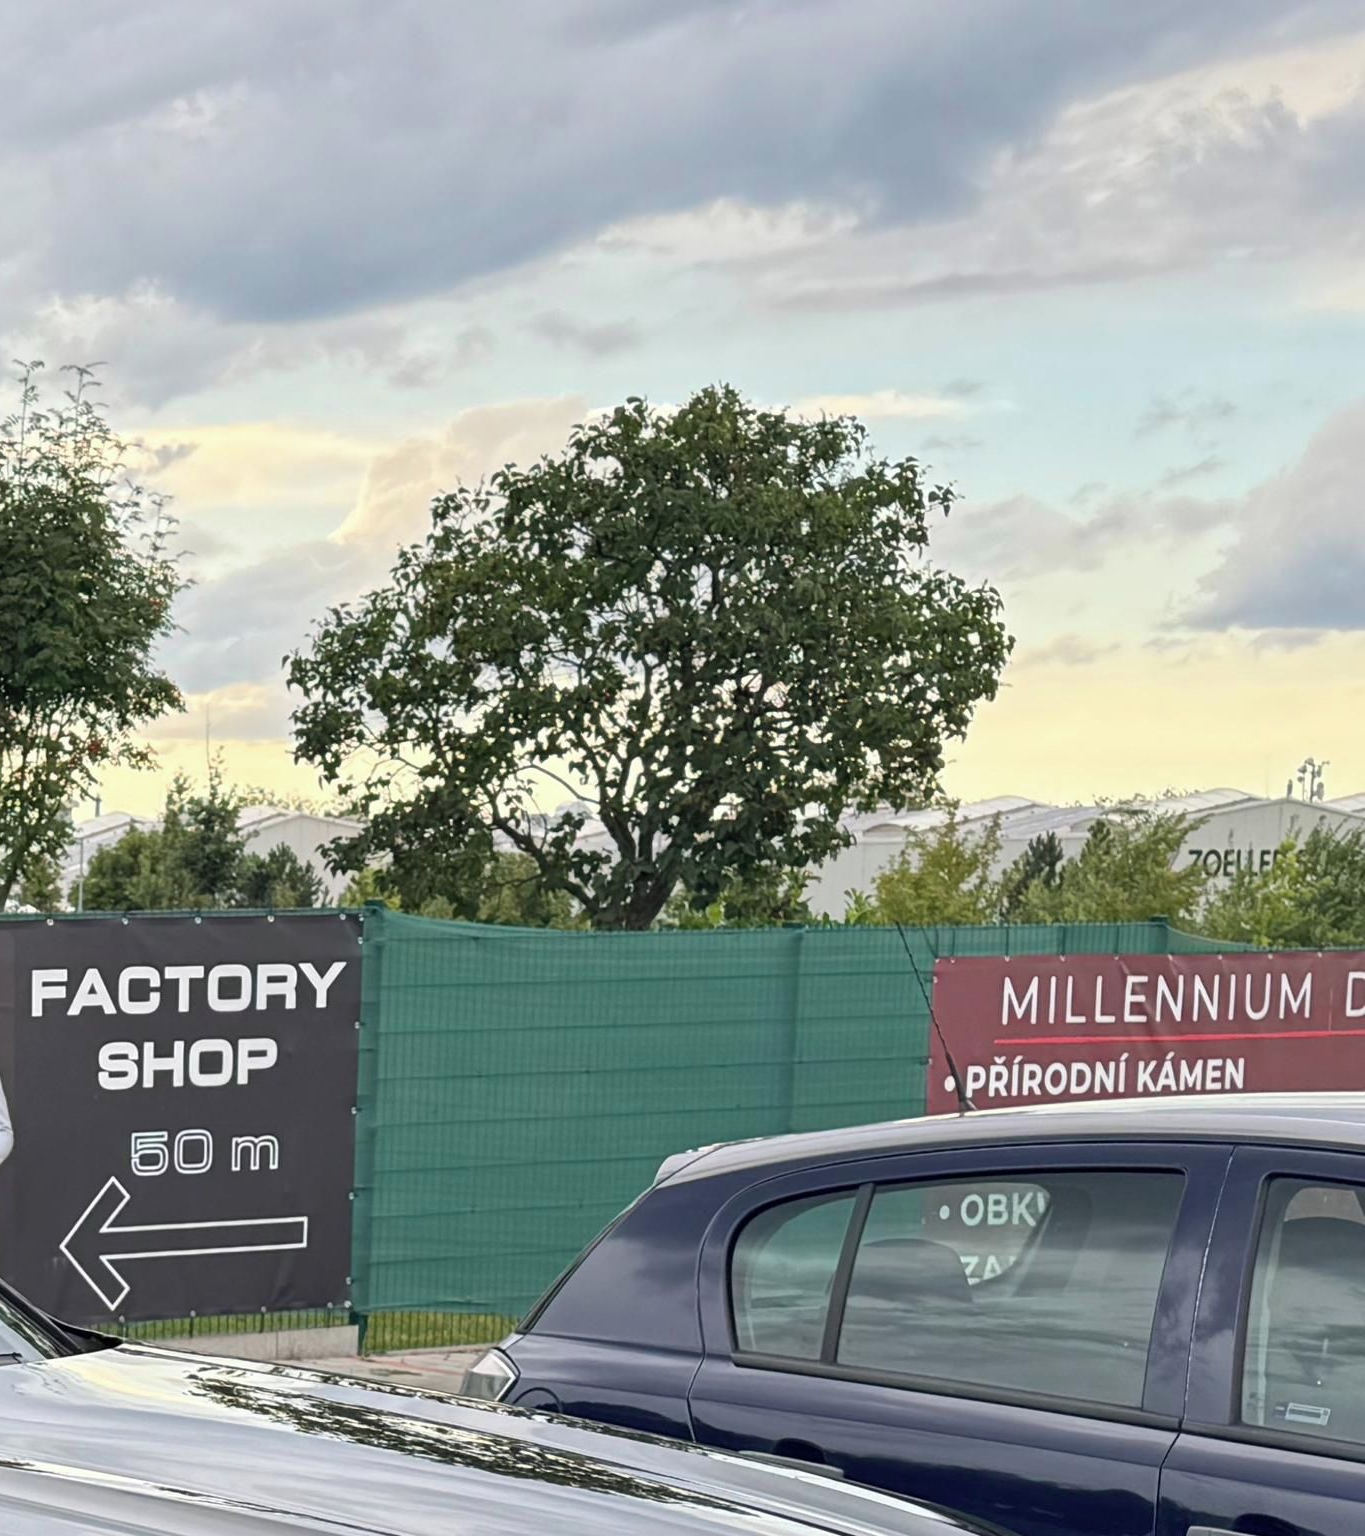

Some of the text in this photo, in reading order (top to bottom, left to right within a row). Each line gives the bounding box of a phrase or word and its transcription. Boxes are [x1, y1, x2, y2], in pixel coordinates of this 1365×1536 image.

[31, 961, 347, 1017] FACTORY
[1001, 972, 1312, 1025] MILLENNIUM
[97, 1037, 278, 1090] SHOP
[966, 1051, 1246, 1098] PŘÍRODNÍ KÁMEN
[130, 1129, 279, 1176] 50 m
